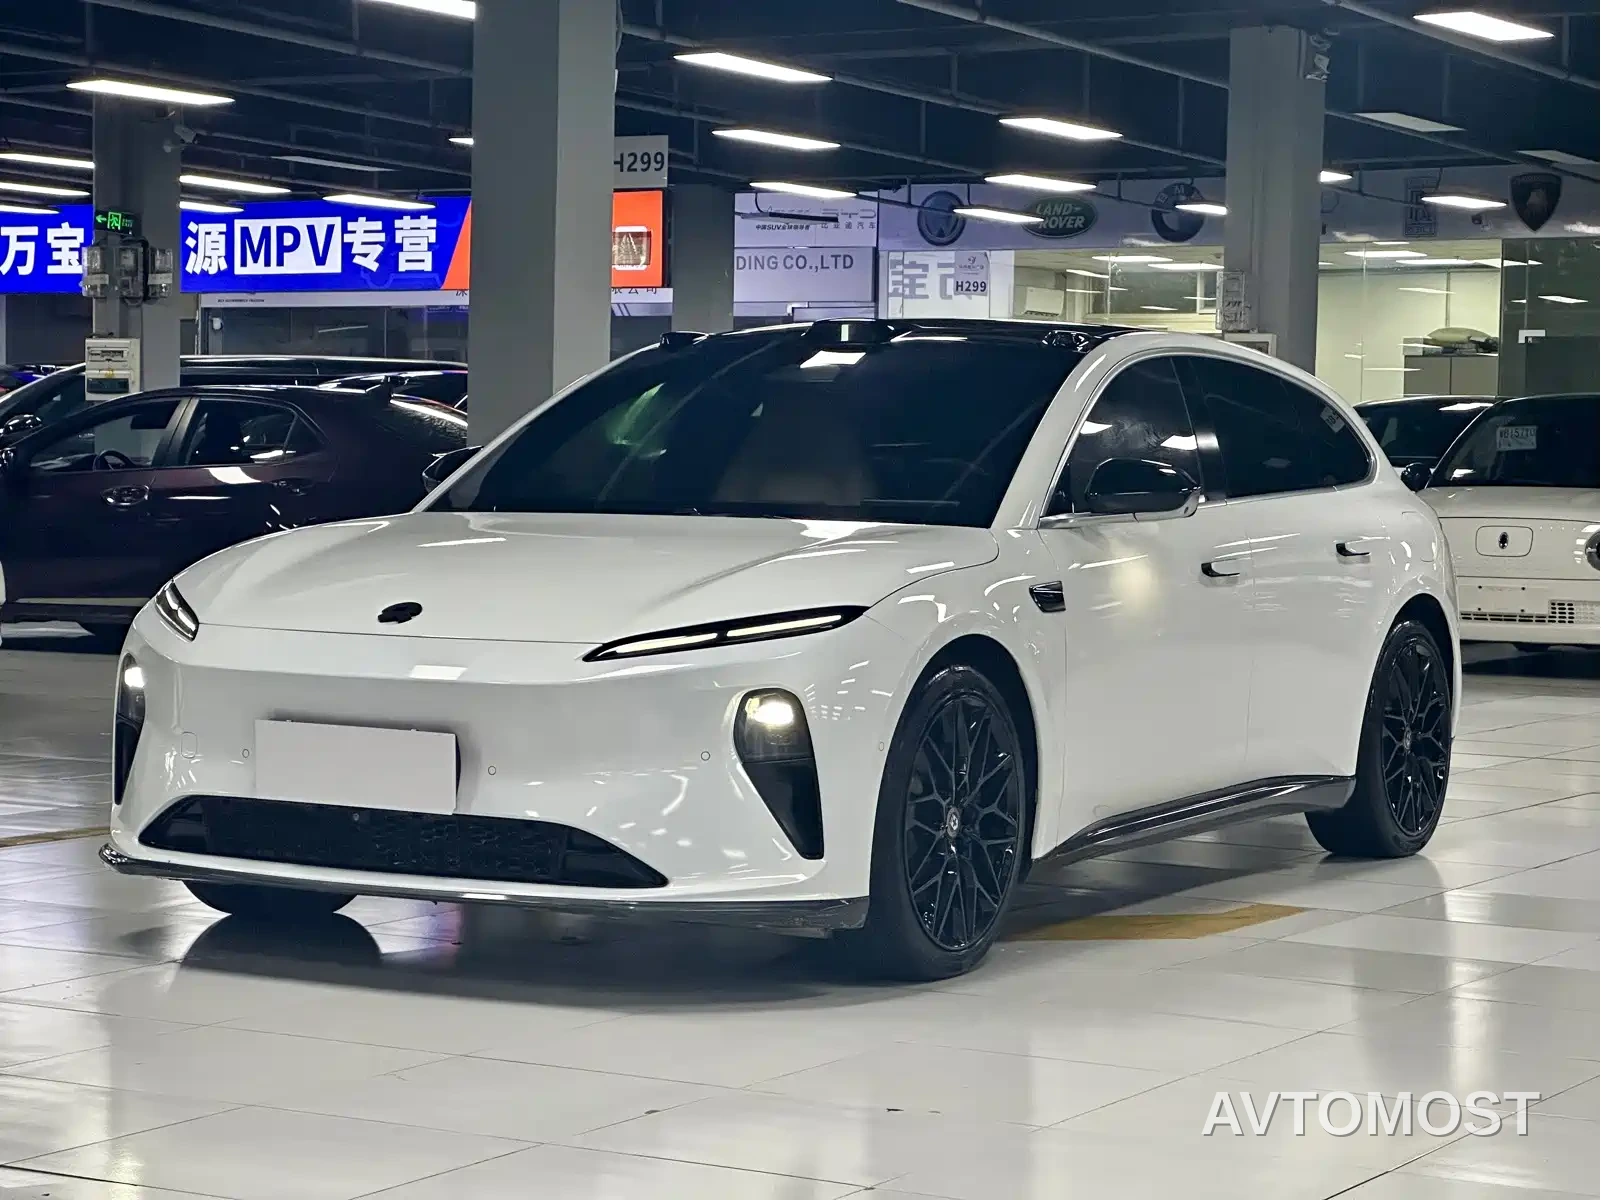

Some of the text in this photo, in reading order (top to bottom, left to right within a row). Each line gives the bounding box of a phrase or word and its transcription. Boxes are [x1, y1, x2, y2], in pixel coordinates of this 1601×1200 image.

[0, 221, 85, 276] 万宝
[735, 255, 779, 271] DING
[955, 280, 987, 293] H299
